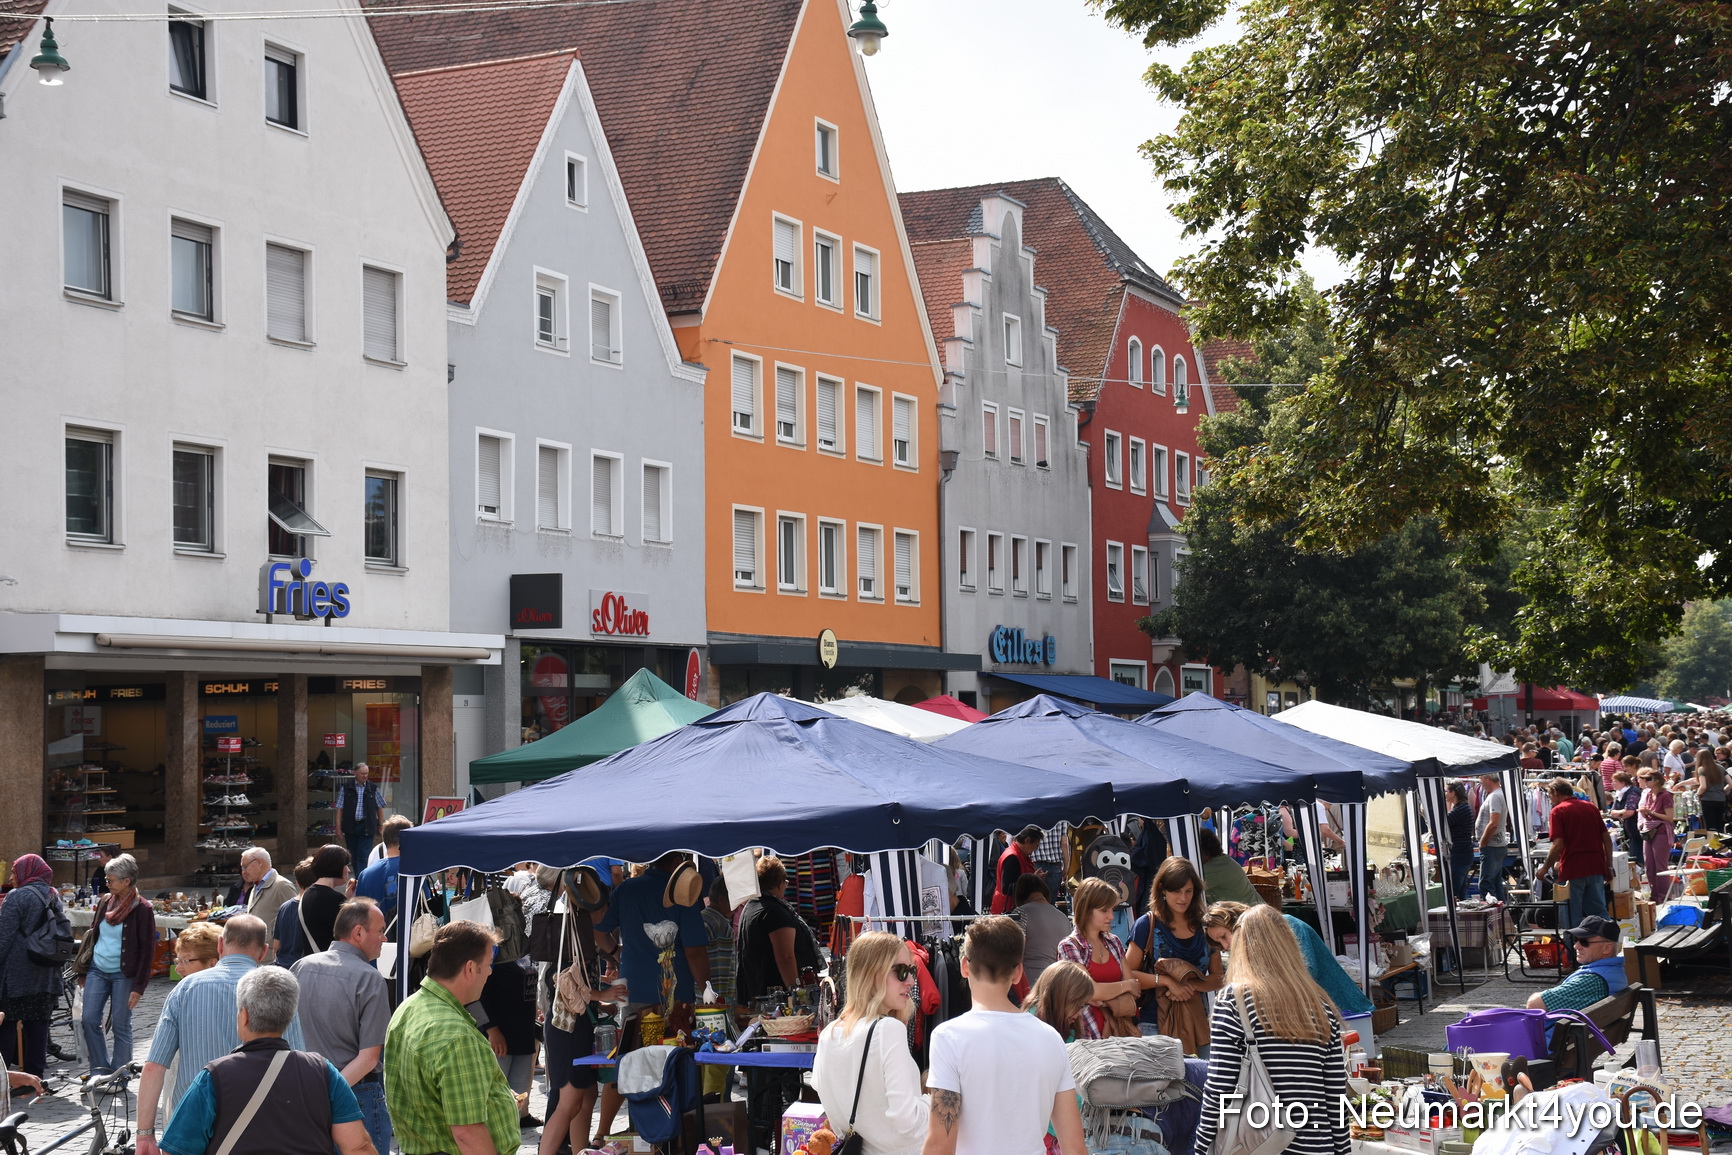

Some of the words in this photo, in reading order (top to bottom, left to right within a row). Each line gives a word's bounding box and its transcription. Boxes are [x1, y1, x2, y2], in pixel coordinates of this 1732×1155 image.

[592, 591, 650, 636] s.Oliver
[205, 683, 249, 694] SCHUH
[342, 679, 388, 690] FRIES
[110, 688, 144, 698] FRIES
